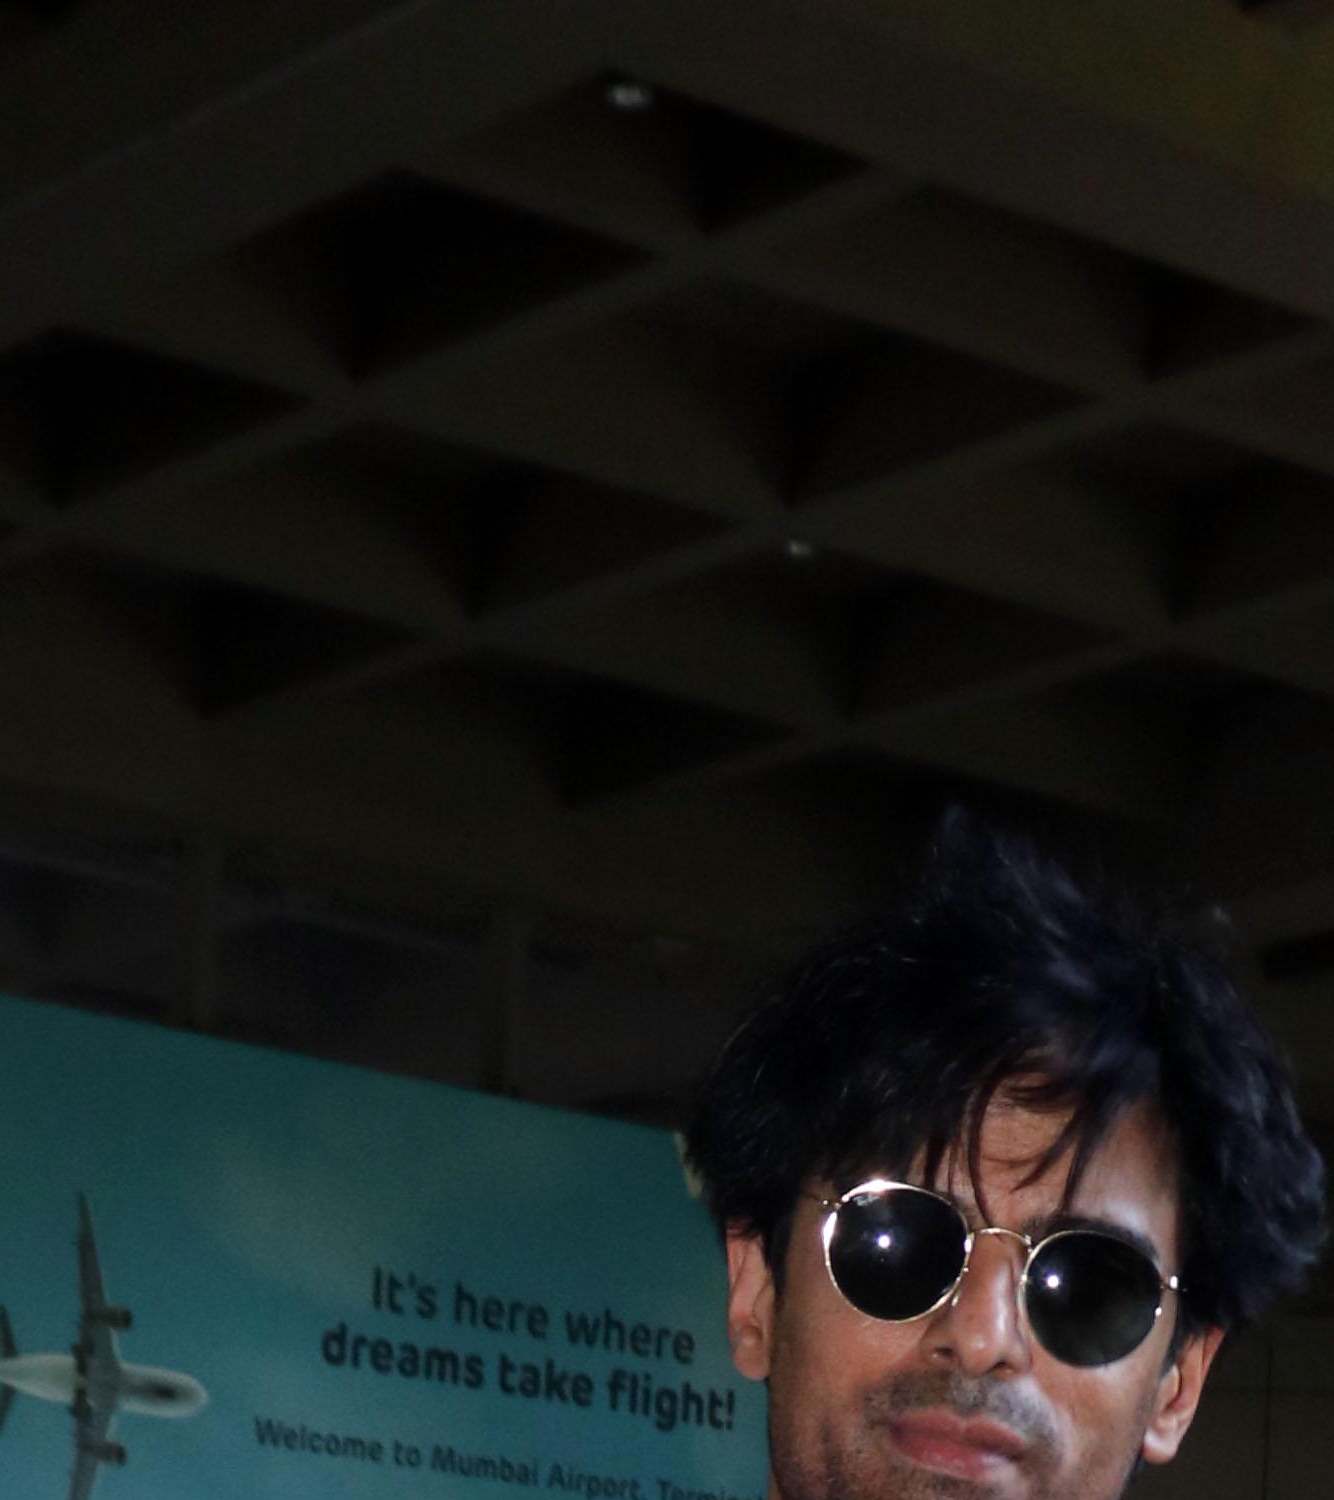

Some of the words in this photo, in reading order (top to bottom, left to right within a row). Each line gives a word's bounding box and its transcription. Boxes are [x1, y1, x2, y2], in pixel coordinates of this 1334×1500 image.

[371, 1266, 437, 1321] It's
[453, 1281, 549, 1339] here
[565, 1308, 696, 1365] where
[320, 1321, 484, 1390] dreams
[498, 1352, 594, 1408] take
[607, 1368, 736, 1431] flight!
[254, 1416, 383, 1463] Welcome
[393, 1438, 421, 1469] to
[431, 1444, 538, 1488] Mumbai
